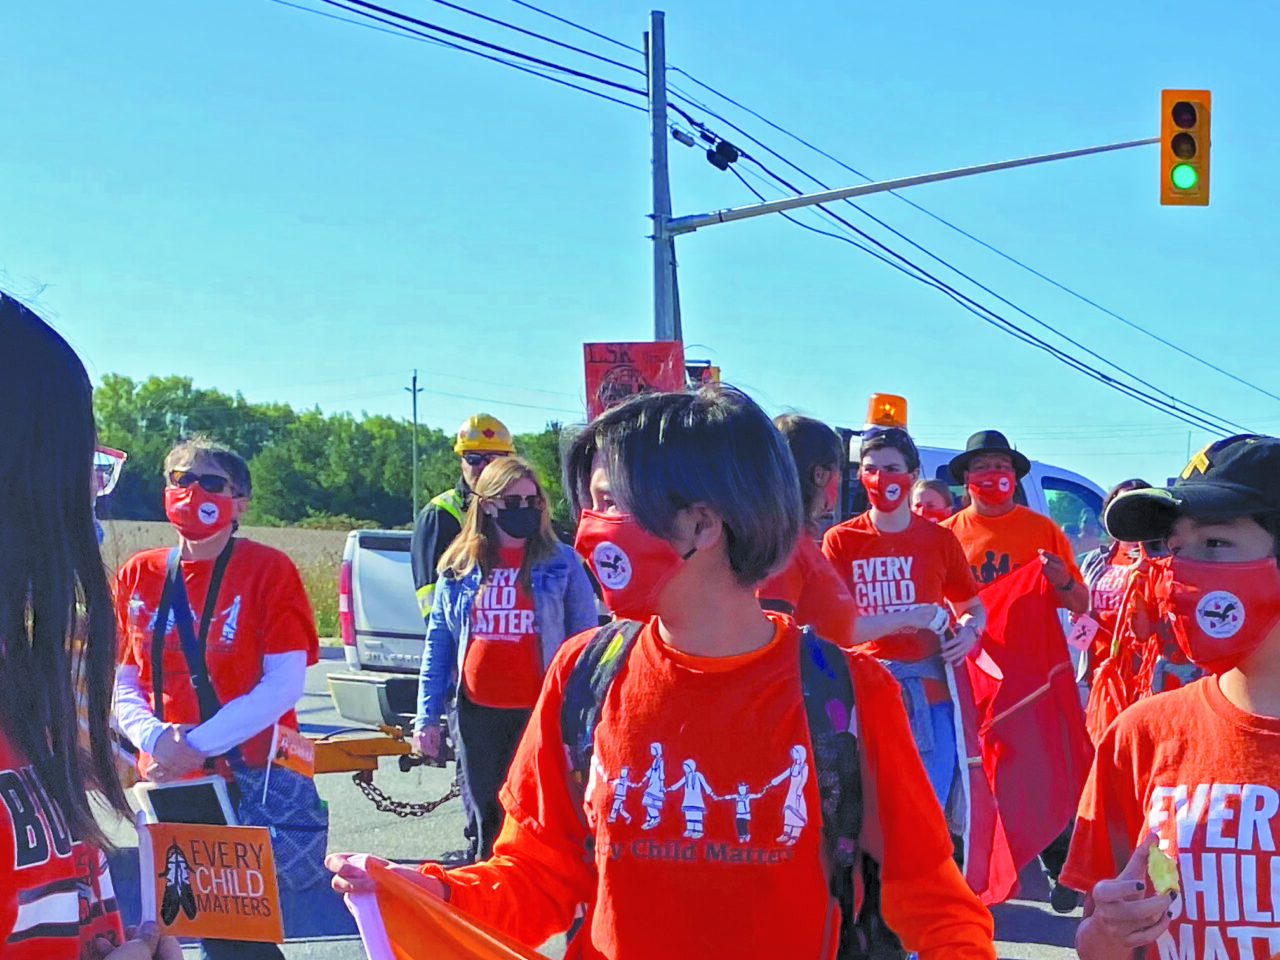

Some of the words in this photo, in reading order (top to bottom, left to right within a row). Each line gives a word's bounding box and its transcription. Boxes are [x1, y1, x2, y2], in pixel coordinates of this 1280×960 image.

[852, 556, 913, 583] EVERY
[855, 580, 916, 608] CHILD
[472, 609, 541, 634] ATTER
[190, 840, 264, 869] EVERY
[631, 838, 696, 862] Child
[195, 866, 265, 897] CHILD
[197, 894, 272, 917] MATTERS
